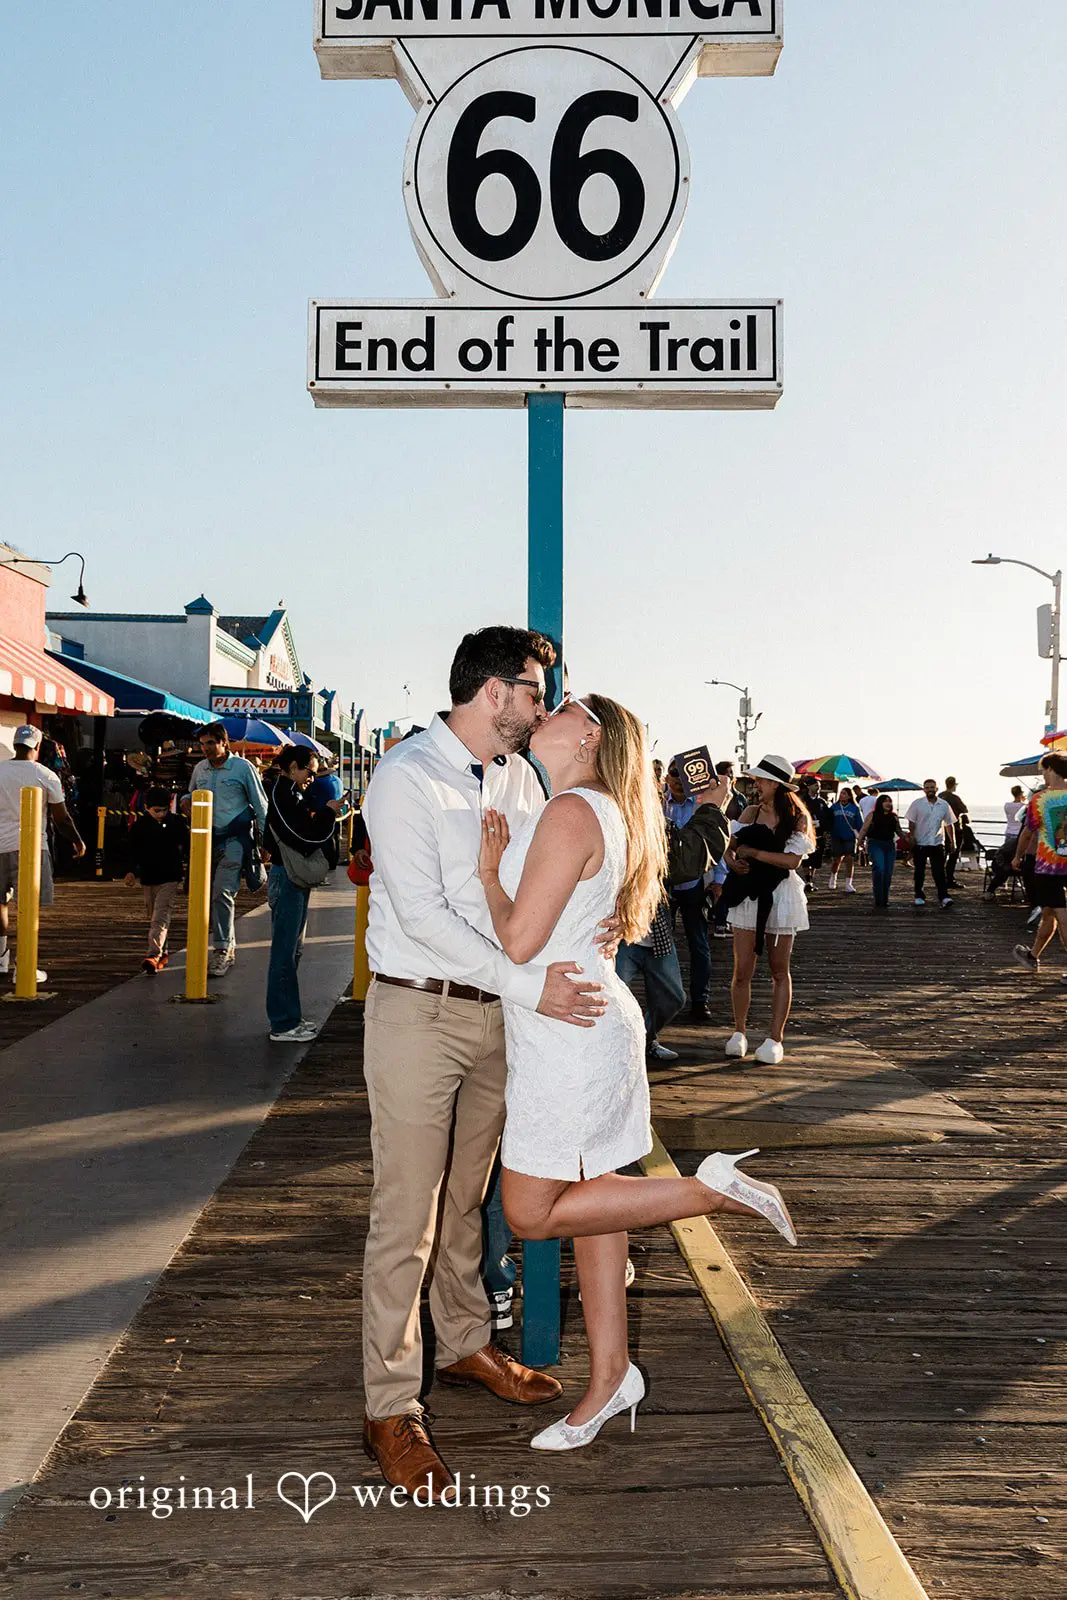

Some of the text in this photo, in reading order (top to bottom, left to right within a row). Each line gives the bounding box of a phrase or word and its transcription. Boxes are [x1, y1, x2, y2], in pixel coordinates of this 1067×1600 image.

[447, 90, 646, 262] 66
[335, 315, 757, 372] End of the Trail
[214, 697, 287, 708] PLAYLAND
